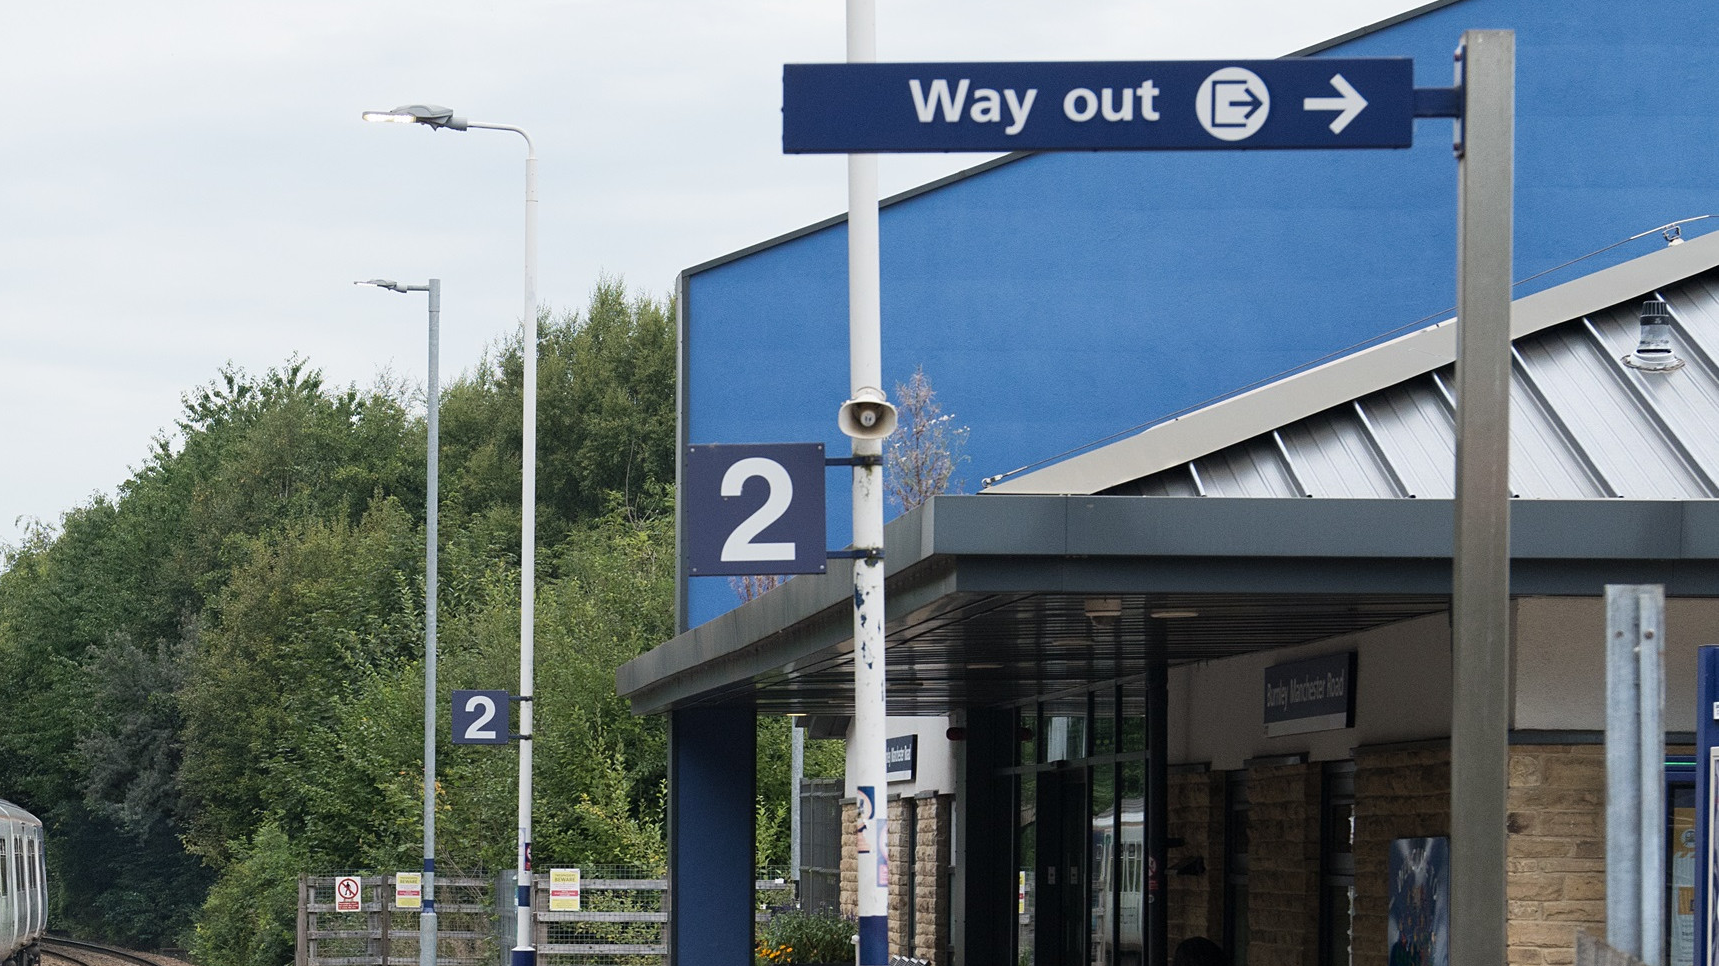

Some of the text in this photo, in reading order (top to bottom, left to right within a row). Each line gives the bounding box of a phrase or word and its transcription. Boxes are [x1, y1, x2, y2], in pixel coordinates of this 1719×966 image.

[909, 79, 1160, 136] Way out
[720, 457, 796, 562] 2
[1290, 675, 1326, 703] Manchester
[1326, 668, 1345, 698] Road
[464, 695, 496, 739] 2
